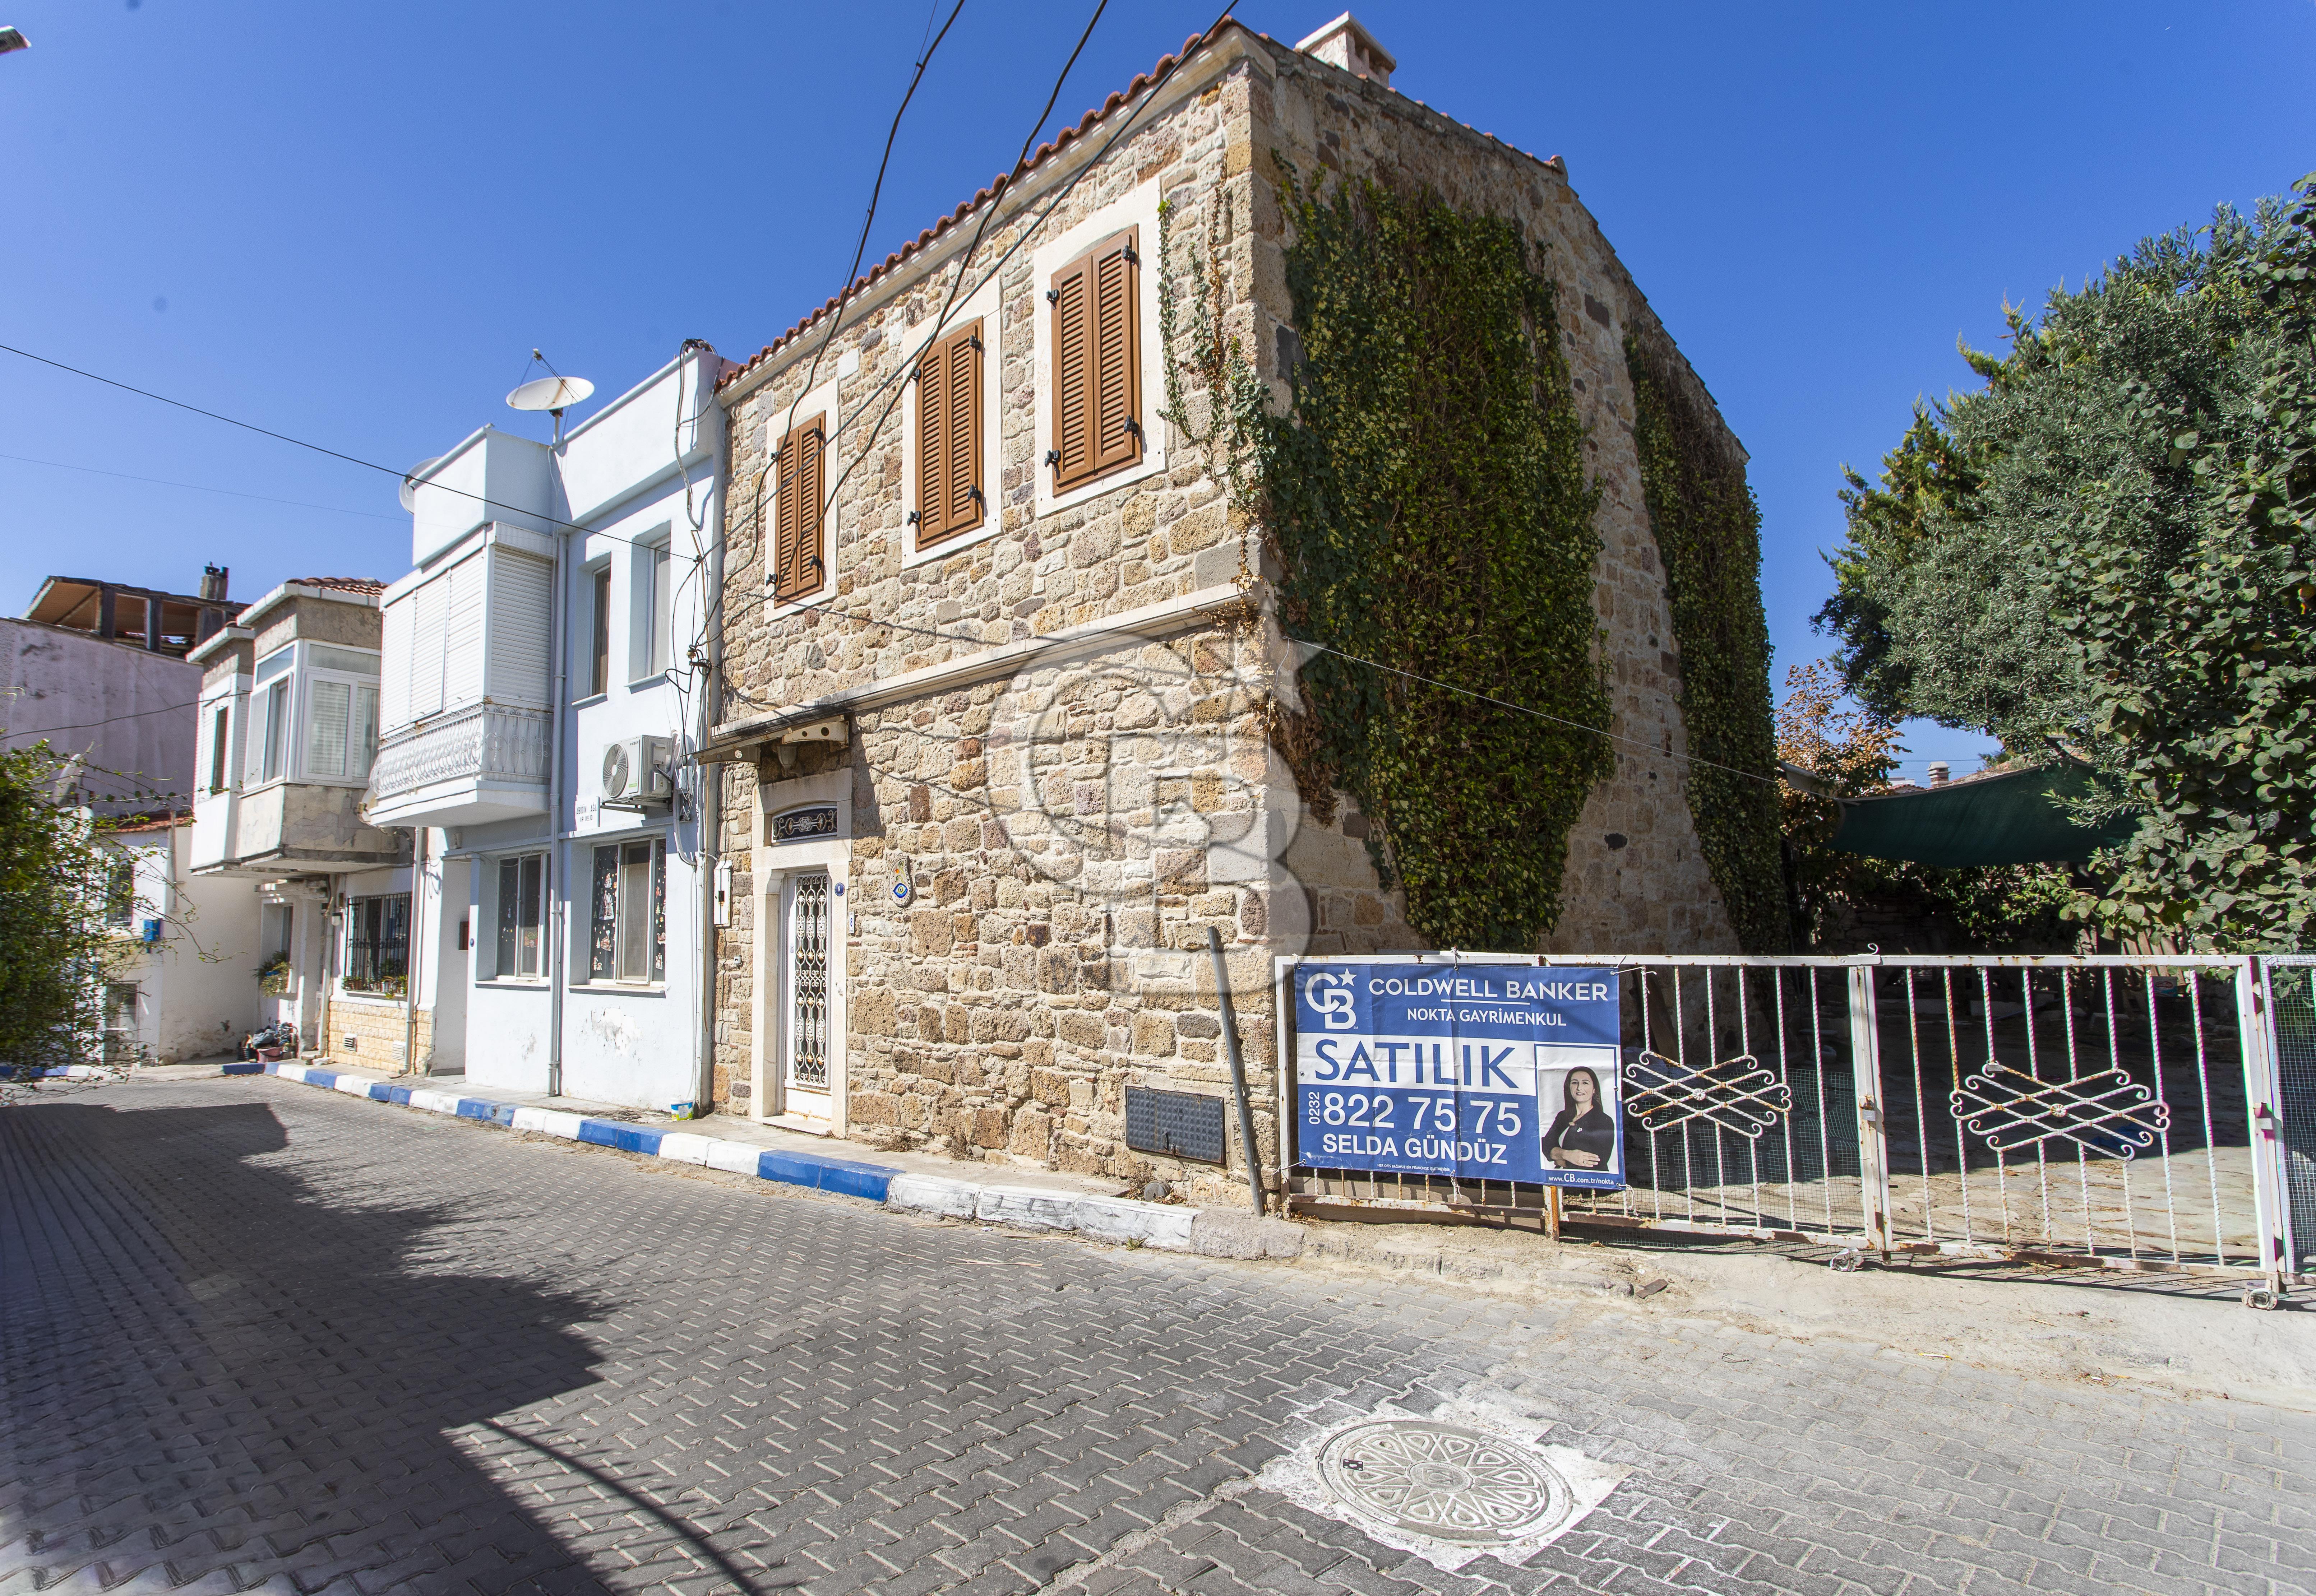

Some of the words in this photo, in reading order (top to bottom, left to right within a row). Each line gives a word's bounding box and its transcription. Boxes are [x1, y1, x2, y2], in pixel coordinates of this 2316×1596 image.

[850, 918, 852, 927] 8
[1369, 978, 1498, 997] COLDWELL
[1506, 981, 1608, 1001] BANKER
[1407, 1008, 1456, 1021] NOKTA
[1460, 1008, 1567, 1026] GAYRİMENKUL
[1315, 1039, 1520, 1088] SATILIK
[1308, 1092, 1320, 1124] 0232
[1323, 1092, 1394, 1128] 822
[1408, 1097, 1456, 1132] 75
[1470, 1100, 1521, 1136] 75
[1323, 1133, 1398, 1156] SELDA
[1405, 1135, 1507, 1164] GÜNDÜZ
[1548, 1173, 1614, 1185] www.CB.com.tr/nokta
